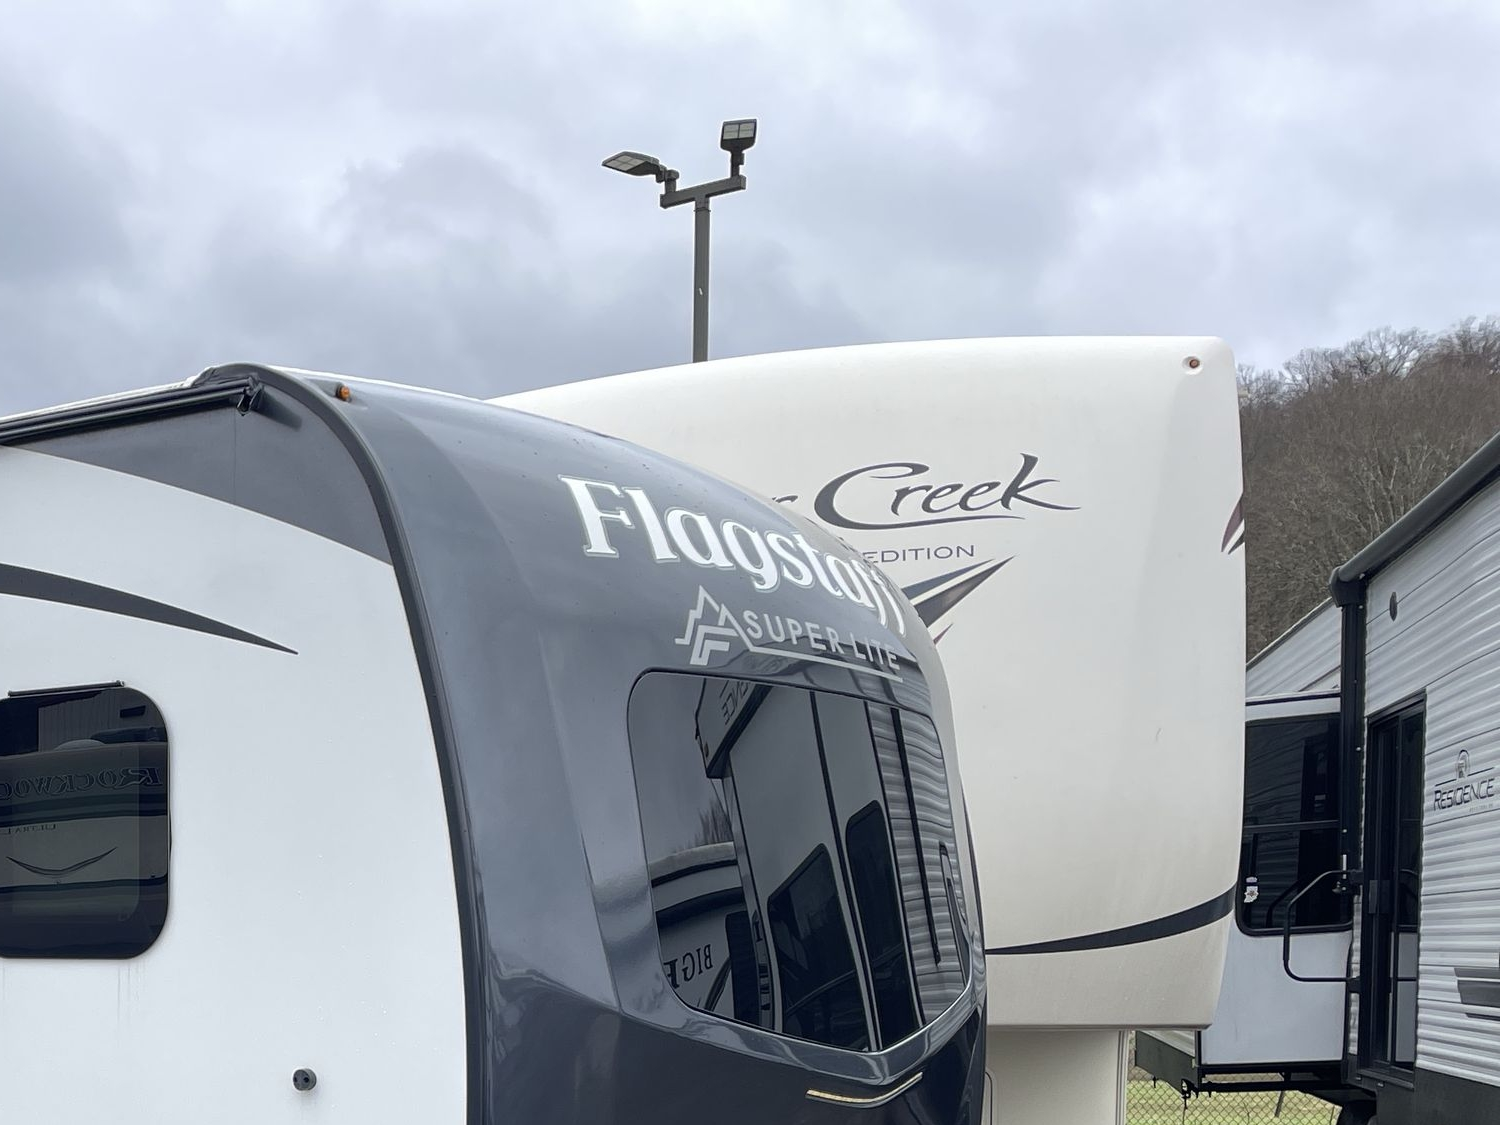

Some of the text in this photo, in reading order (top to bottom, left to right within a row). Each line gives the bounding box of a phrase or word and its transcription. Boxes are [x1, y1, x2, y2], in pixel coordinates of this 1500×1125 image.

[814, 452, 1081, 530] Creek
[558, 473, 906, 638] Flagstaff
[862, 545, 974, 564] EDITION
[743, 609, 901, 670] SUPER LITE
[1433, 778, 1495, 811] RESIDENCE
